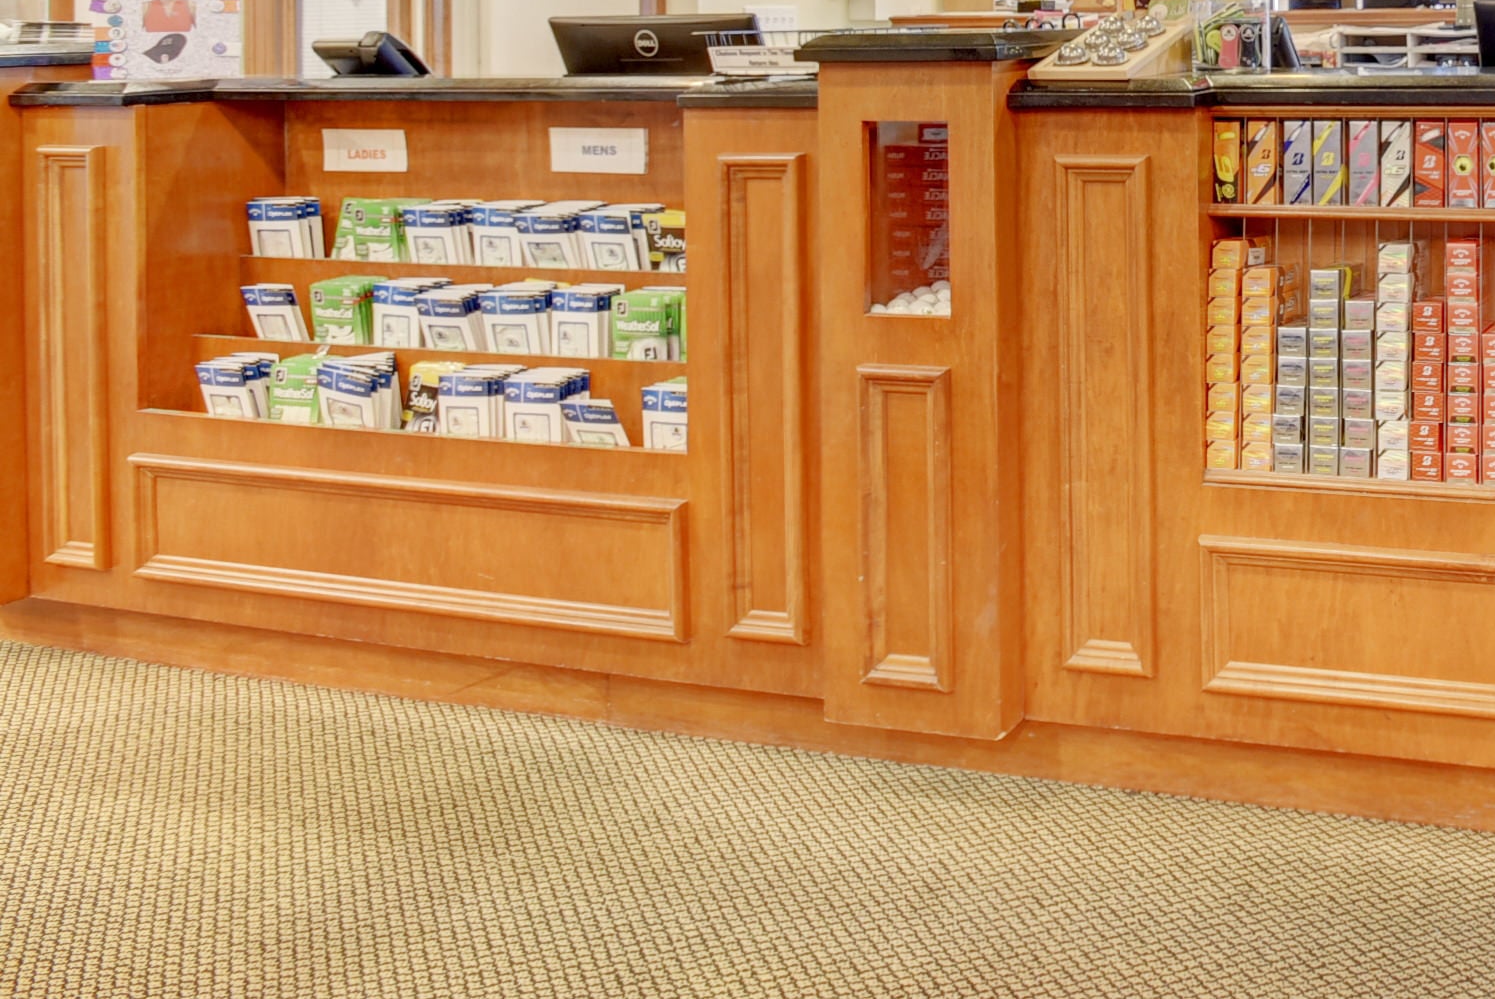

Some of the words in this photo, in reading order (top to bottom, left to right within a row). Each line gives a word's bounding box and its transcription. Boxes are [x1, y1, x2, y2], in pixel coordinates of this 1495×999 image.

[636, 38, 658, 49] DELL
[347, 149, 386, 160] LADIES
[581, 144, 617, 156] MENS
